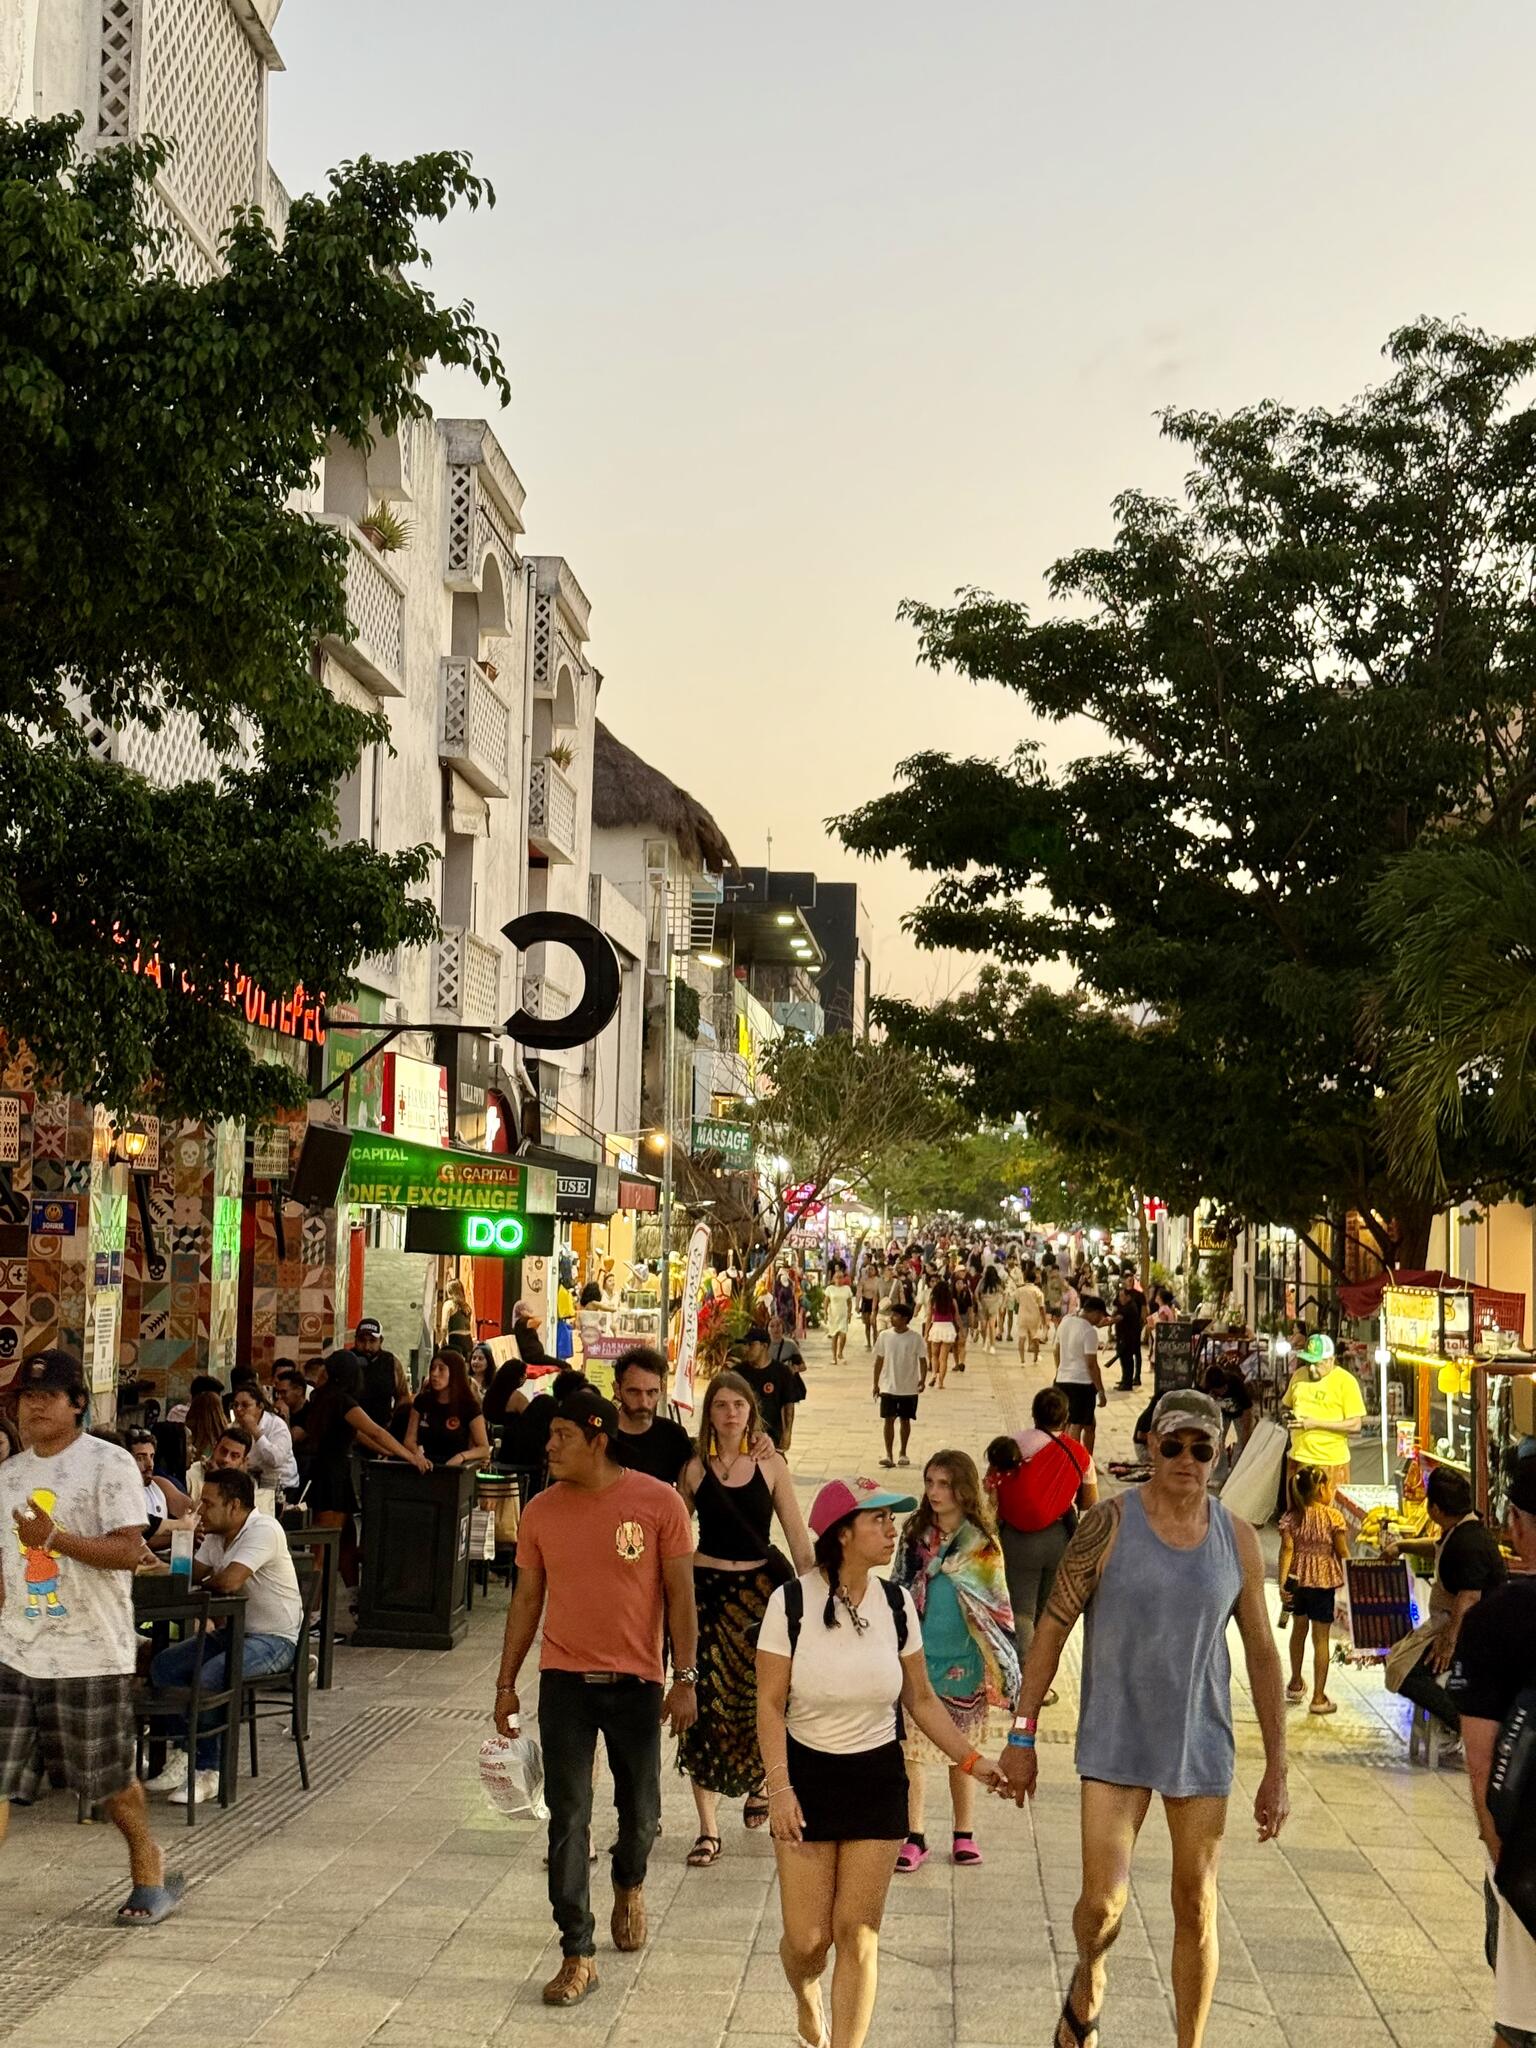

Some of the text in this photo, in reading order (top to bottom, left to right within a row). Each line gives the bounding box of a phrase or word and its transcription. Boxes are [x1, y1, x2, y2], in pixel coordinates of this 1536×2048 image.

[696, 1126, 749, 1151] MASSAGE
[352, 1148, 408, 1161] CAPITAL
[462, 1168, 516, 1182] CAPITAL
[349, 1183, 518, 1209] ONEY EXCHANGE
[467, 1216, 523, 1250] DO
